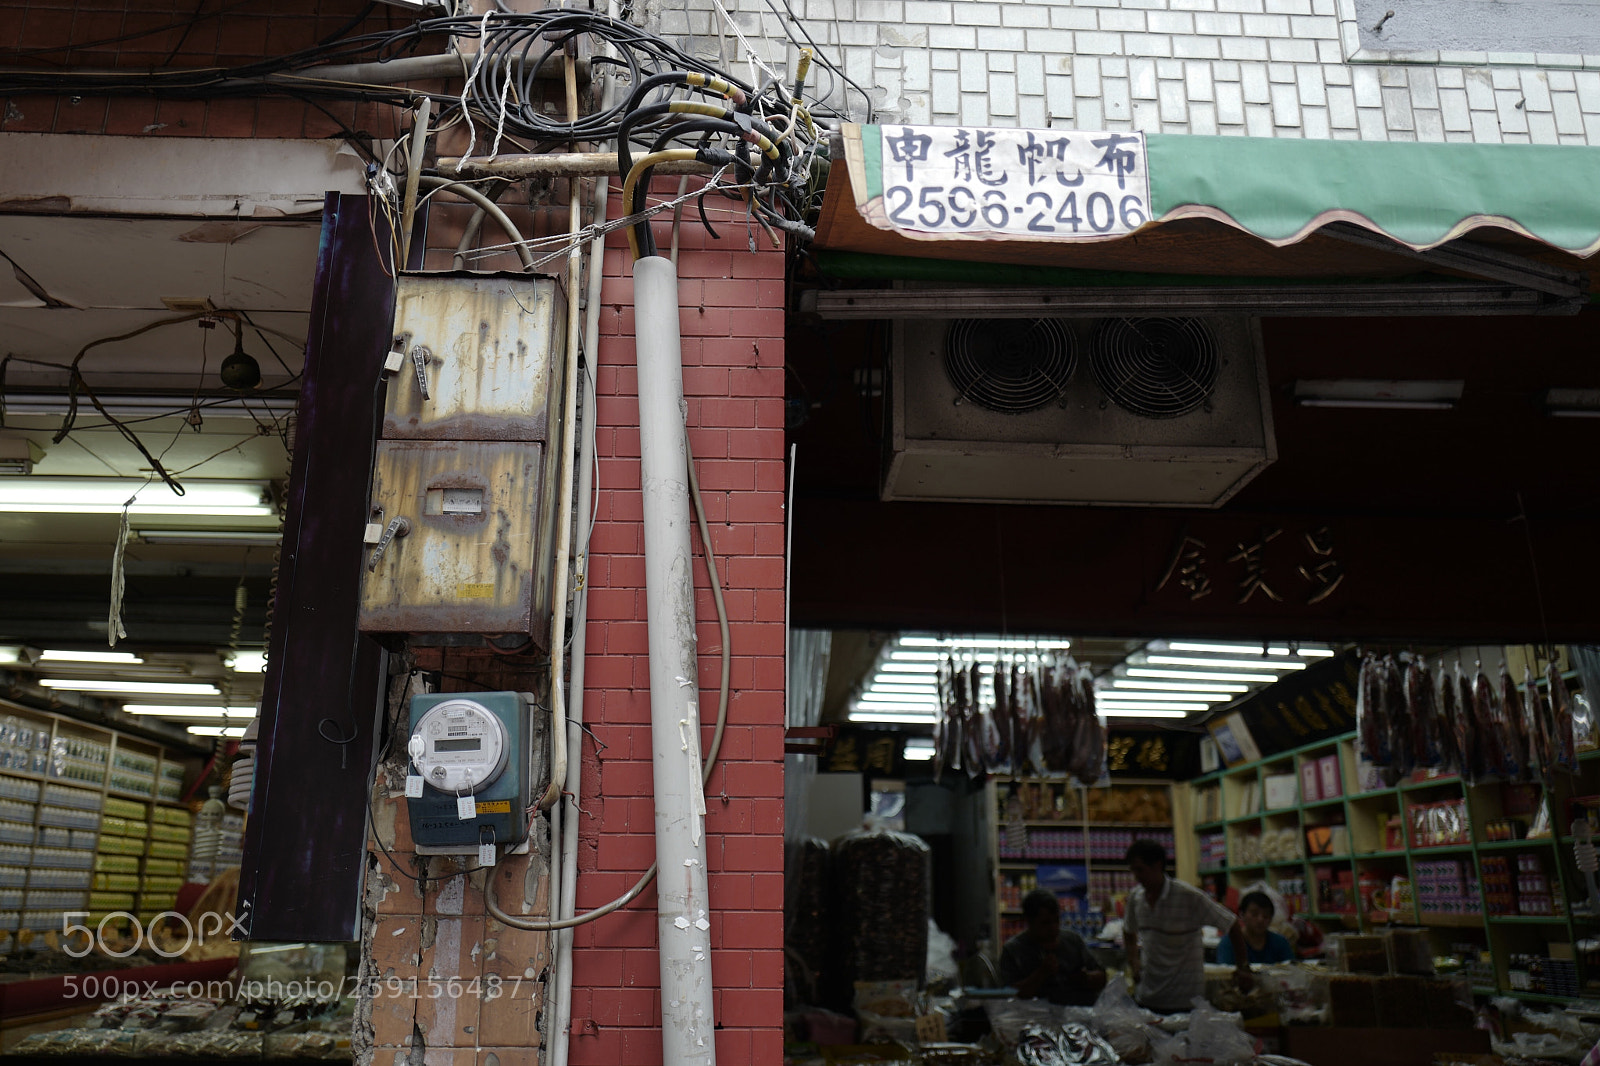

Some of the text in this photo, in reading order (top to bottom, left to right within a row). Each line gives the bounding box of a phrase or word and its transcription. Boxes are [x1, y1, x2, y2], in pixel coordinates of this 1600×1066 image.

[885, 127, 1140, 190] 申龍帆布
[886, 185, 1148, 233] 2596-2406
